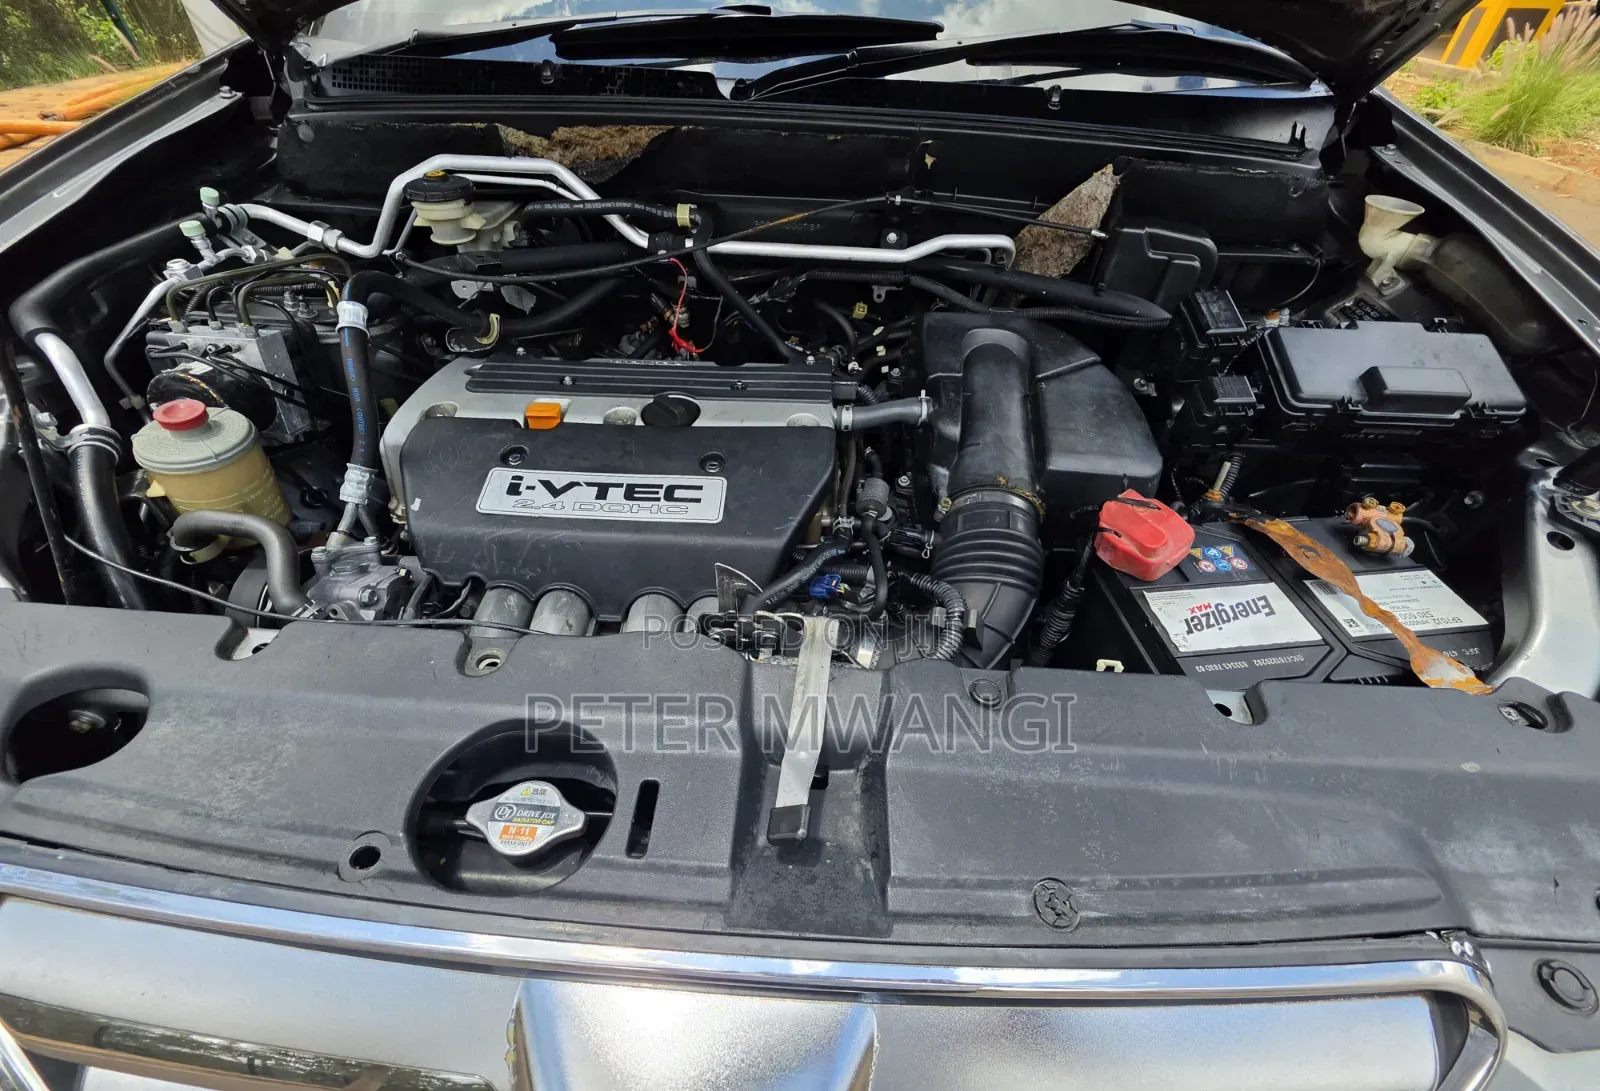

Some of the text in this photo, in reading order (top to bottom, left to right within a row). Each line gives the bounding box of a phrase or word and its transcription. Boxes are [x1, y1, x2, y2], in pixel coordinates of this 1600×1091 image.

[506, 474, 704, 504] i-VTEC
[511, 498, 689, 515] 2.4 DOHC
[1183, 595, 1276, 635] Energizer
[516, 810, 541, 818] DRIVE
[540, 811, 557, 819] JOY
[508, 826, 529, 835] N-11
